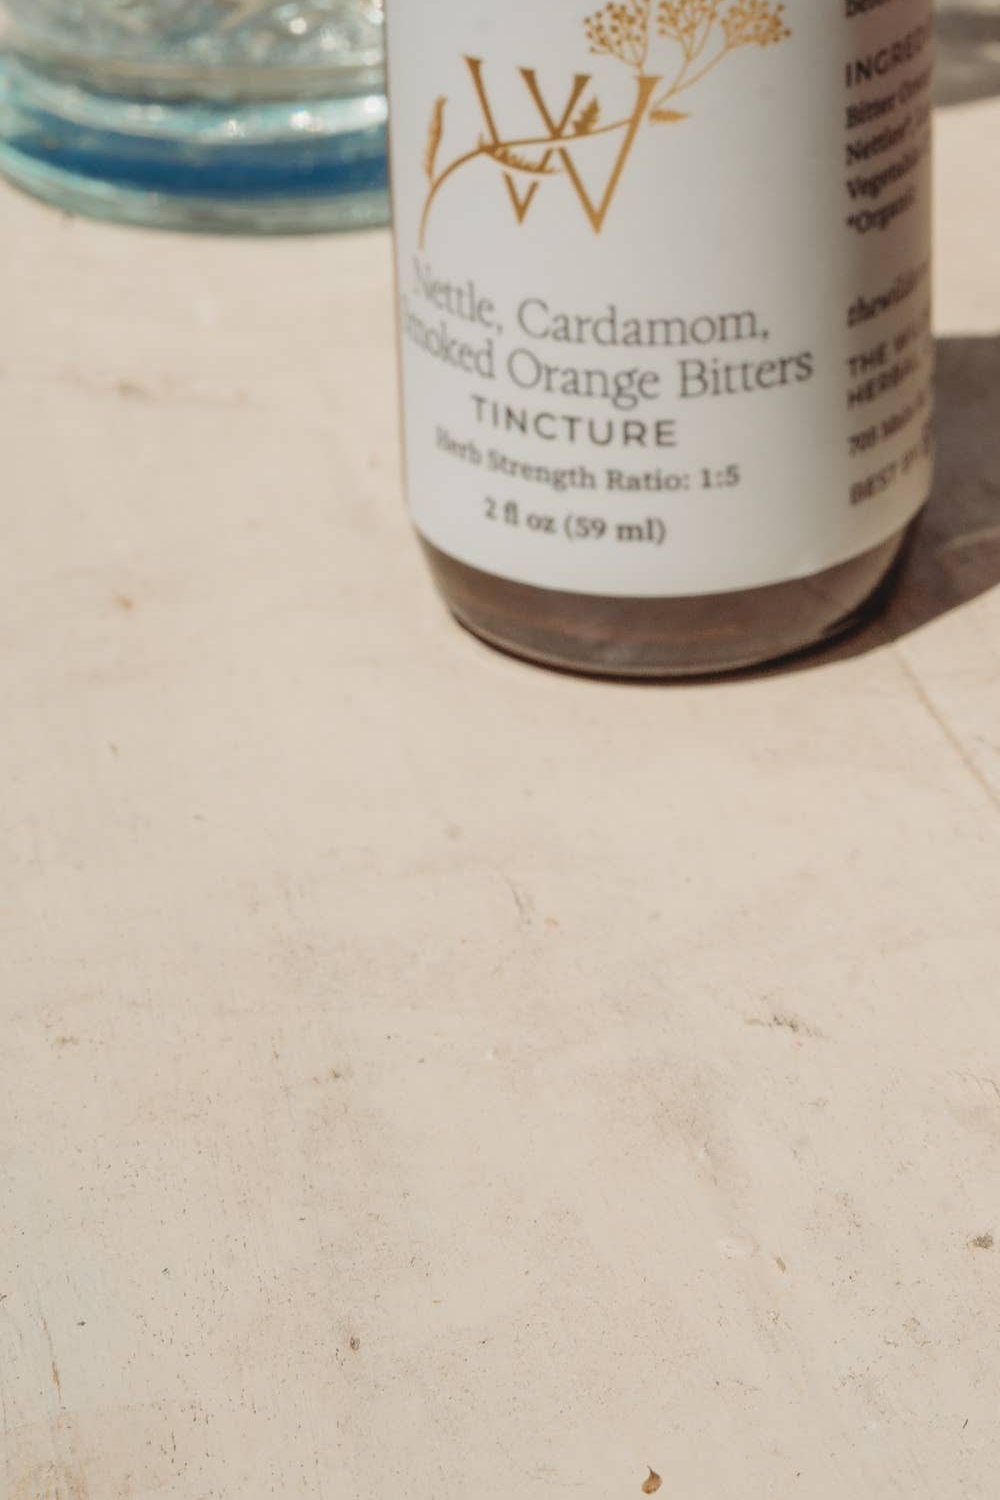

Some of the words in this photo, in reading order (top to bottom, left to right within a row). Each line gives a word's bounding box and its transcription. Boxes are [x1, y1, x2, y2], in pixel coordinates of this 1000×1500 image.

[412, 254, 504, 336] Nettle,
[516, 297, 770, 347] Cardamom,
[402, 296, 496, 380] moked
[506, 347, 661, 411] Orange
[675, 351, 815, 399] Bitters
[470, 394, 678, 448] TINCTURE
[435, 425, 483, 467] Herb
[486, 449, 597, 492] Strength
[606, 467, 691, 493] Ratio:
[700, 463, 741, 490] 1:5
[483, 496, 498, 521] 2
[503, 499, 520, 527] fl
[526, 512, 558, 535] oz
[562, 512, 607, 543] (59
[615, 515, 668, 547] ml)
